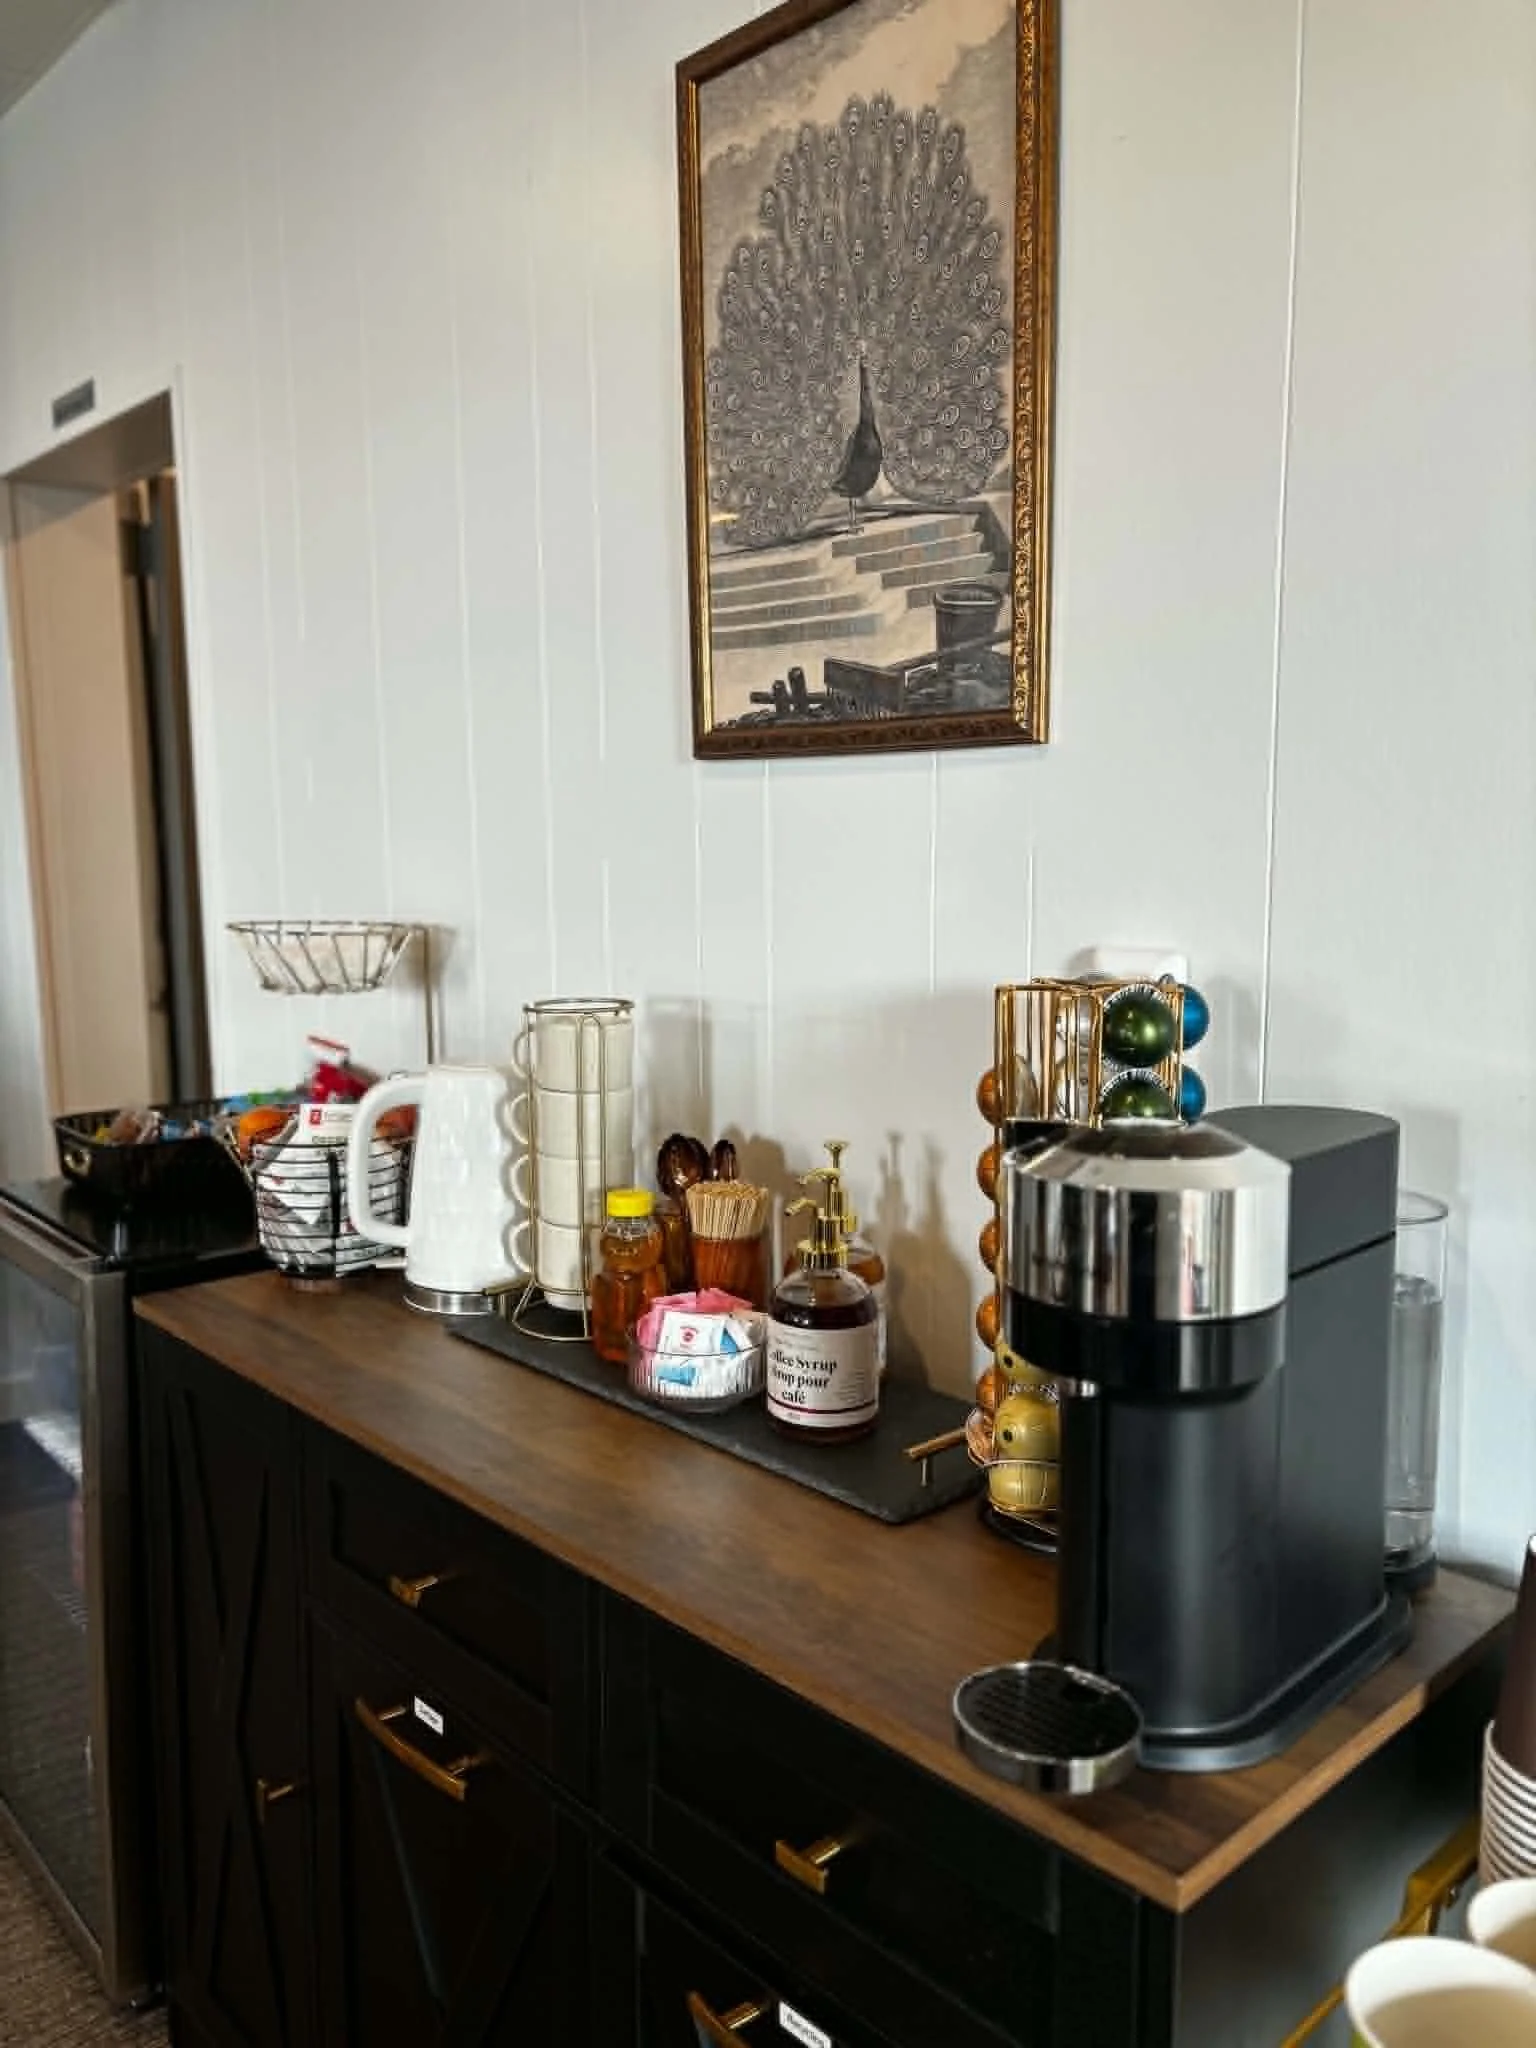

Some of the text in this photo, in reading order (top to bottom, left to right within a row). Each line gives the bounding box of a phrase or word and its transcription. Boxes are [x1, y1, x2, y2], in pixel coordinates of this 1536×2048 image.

[796, 1357, 837, 1376] Syrup
[797, 1376, 831, 1389] pour
[782, 1390, 806, 1404] café
